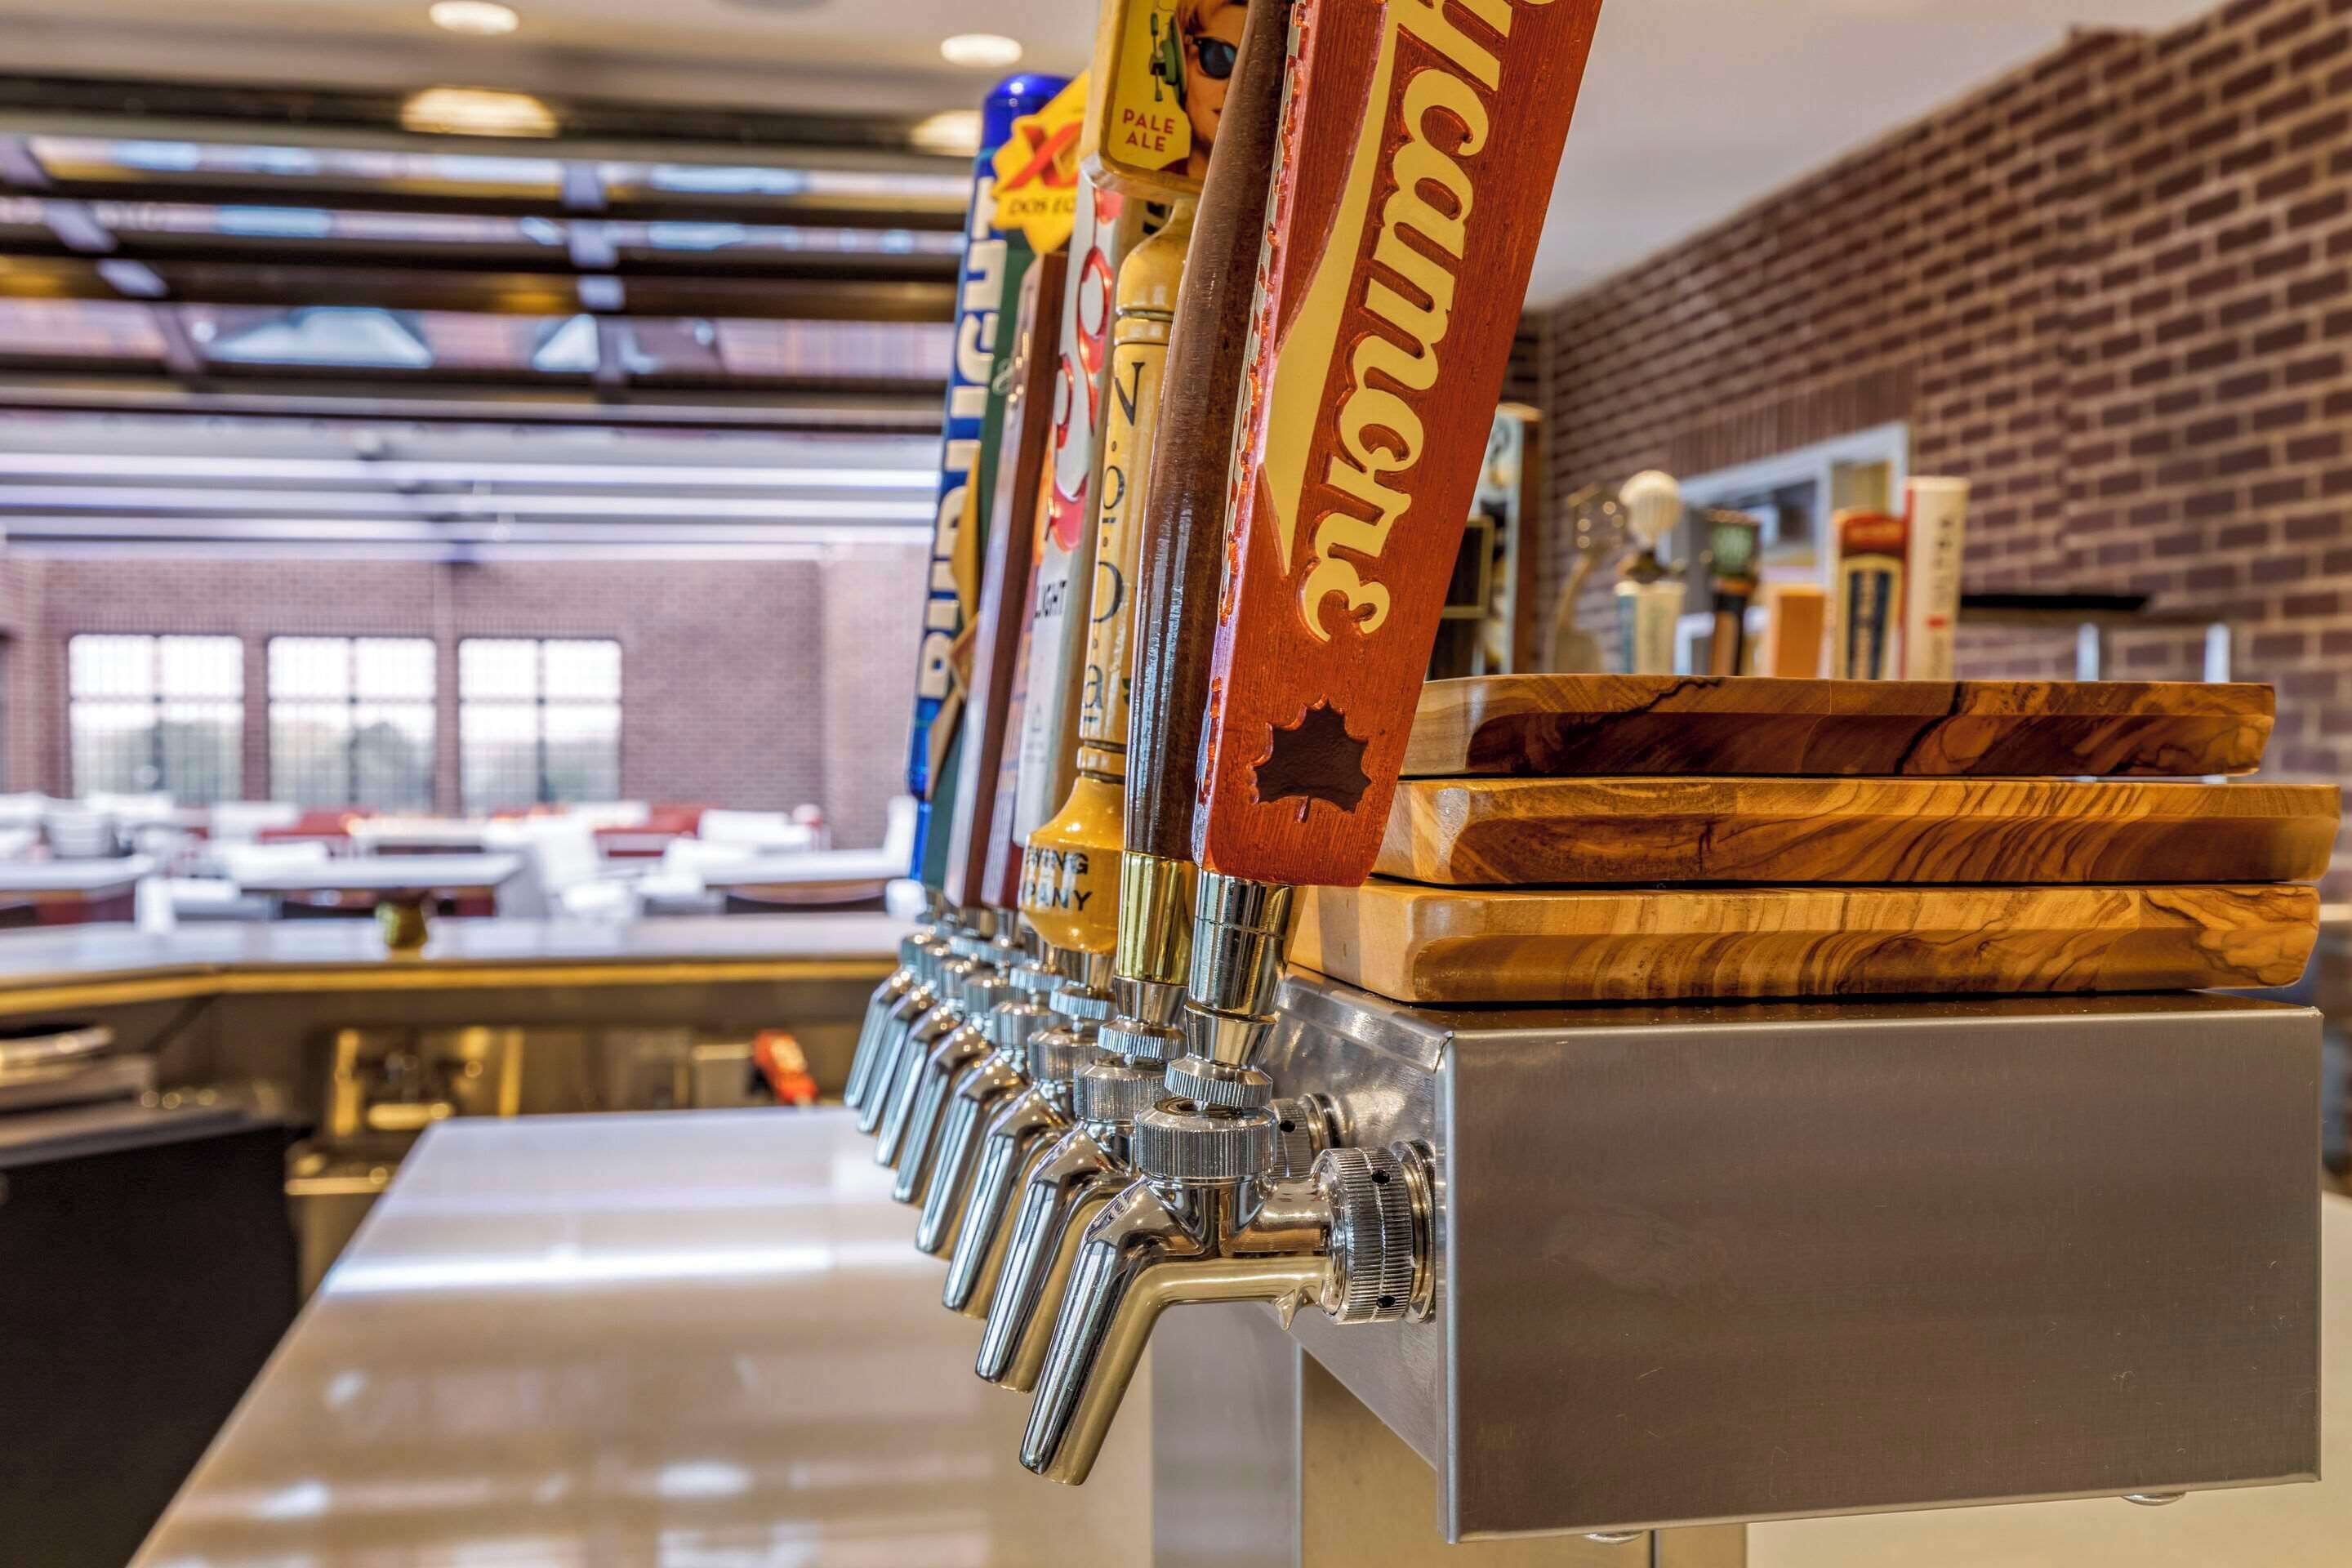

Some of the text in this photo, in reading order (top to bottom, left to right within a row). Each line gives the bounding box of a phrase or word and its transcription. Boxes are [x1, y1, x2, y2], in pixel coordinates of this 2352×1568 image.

[1123, 108, 1176, 135] PALE
[1125, 130, 1167, 153] ALE
[1265, 0, 1556, 642] ycamore
